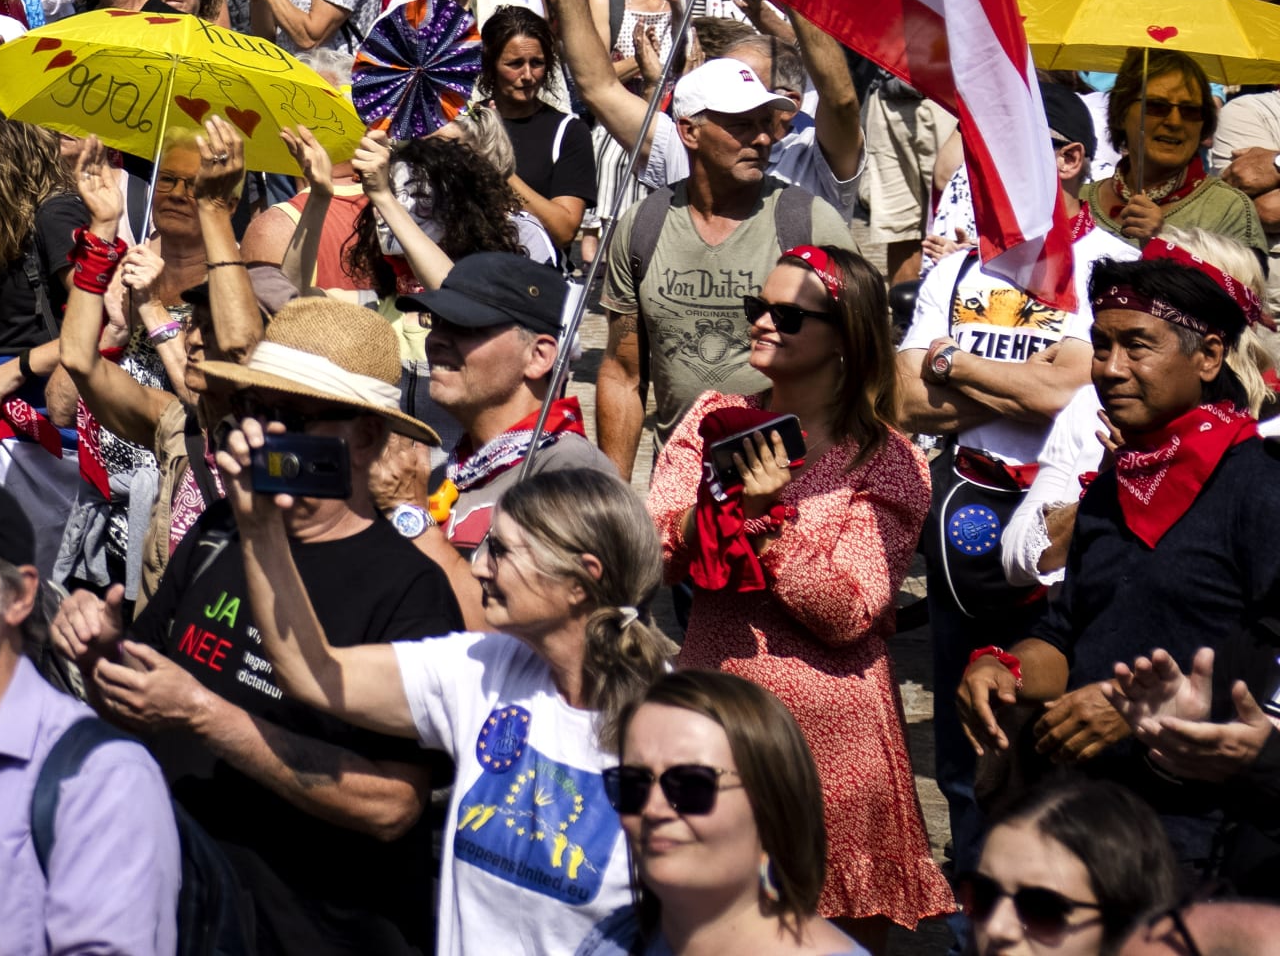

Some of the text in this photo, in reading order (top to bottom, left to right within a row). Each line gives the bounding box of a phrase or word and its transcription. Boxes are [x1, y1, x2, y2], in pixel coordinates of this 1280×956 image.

[662, 268, 763, 299] Von Dutch
[685, 309, 740, 319] ORIGINALS
[204, 591, 241, 629] JA
[178, 623, 233, 672] NEE
